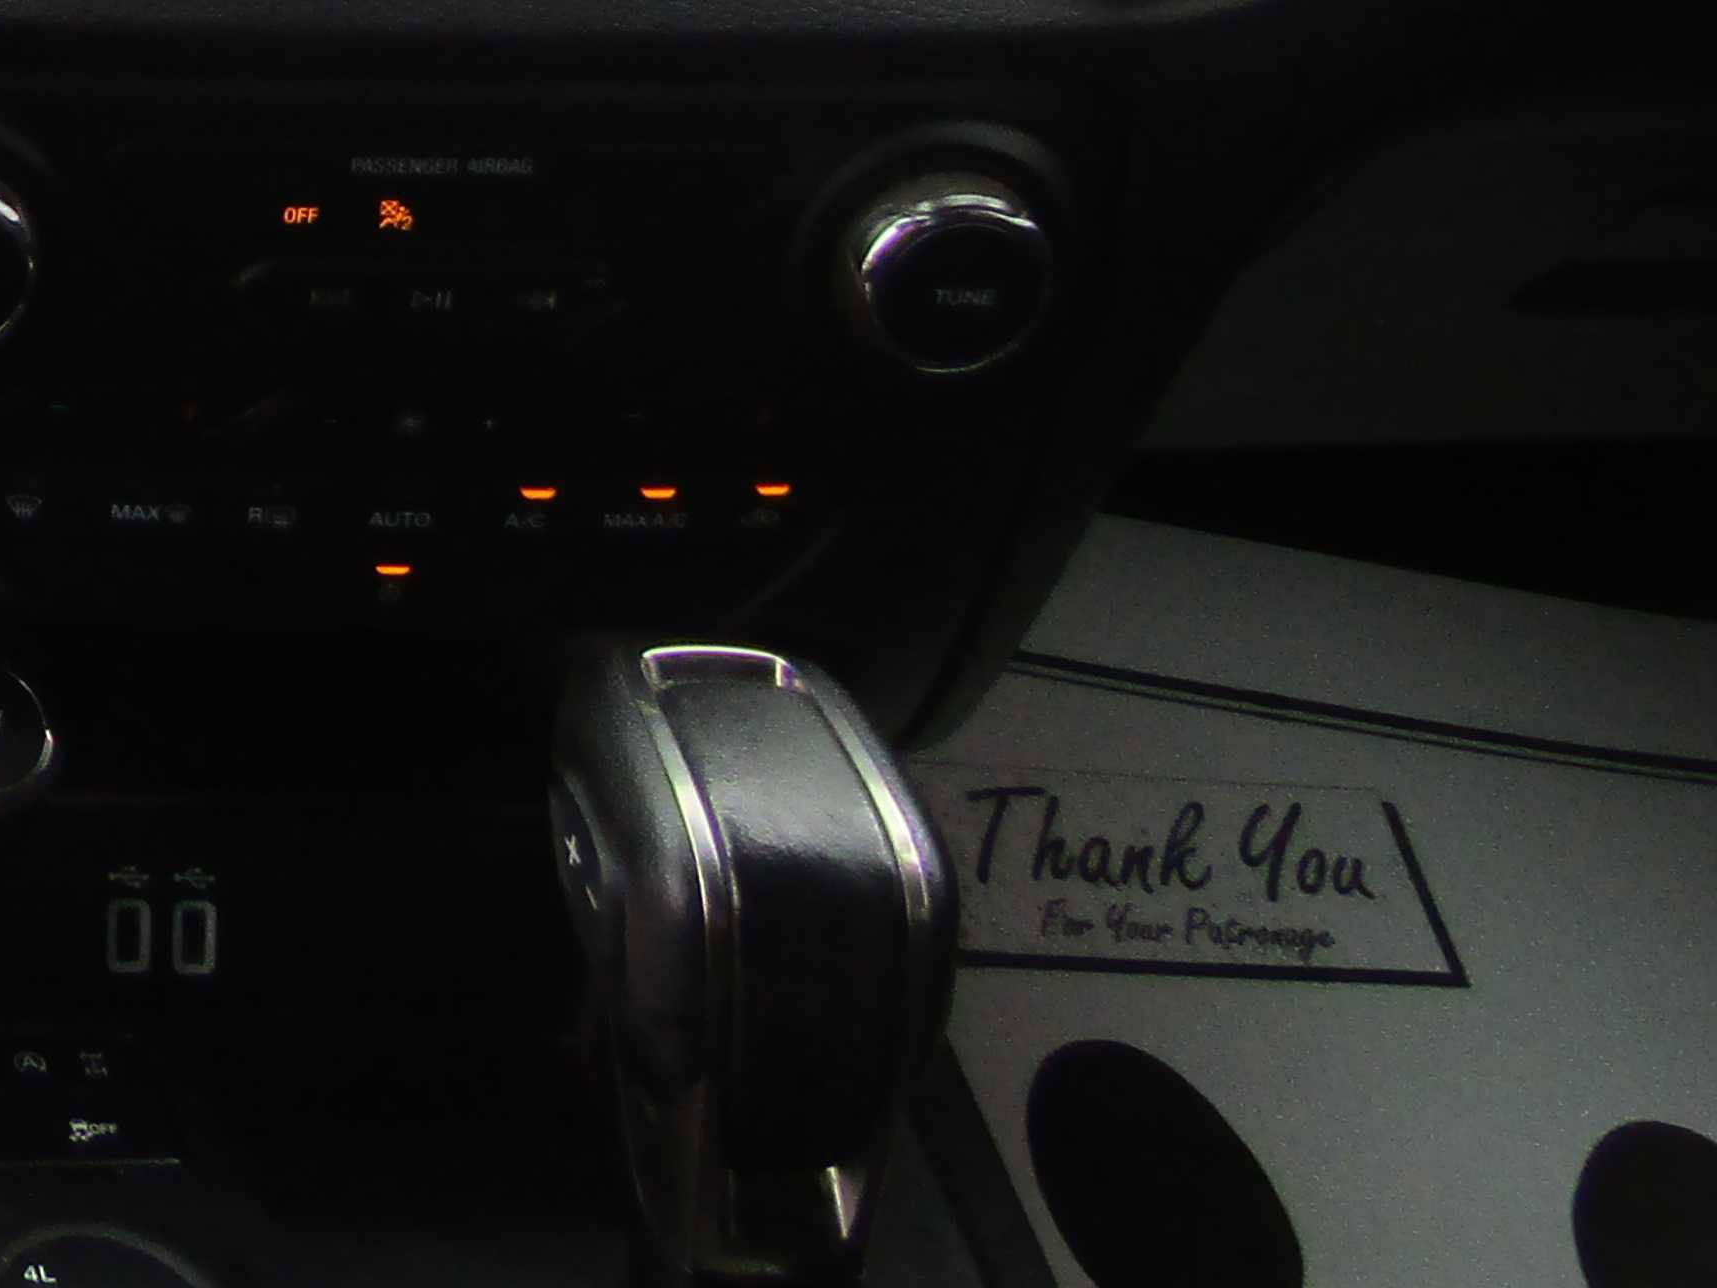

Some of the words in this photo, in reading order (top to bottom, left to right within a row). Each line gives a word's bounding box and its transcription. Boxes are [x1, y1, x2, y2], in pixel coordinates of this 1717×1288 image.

[283, 205, 321, 225] OFF
[110, 503, 160, 521] MAX
[368, 511, 434, 529] AUTO
[968, 786, 1213, 894] Thank
[1239, 802, 1376, 902] You
[1040, 899, 1094, 937] For
[1106, 902, 1173, 943] Your
[1184, 907, 1336, 964] Patronage
[23, 1264, 57, 1285] 4L
